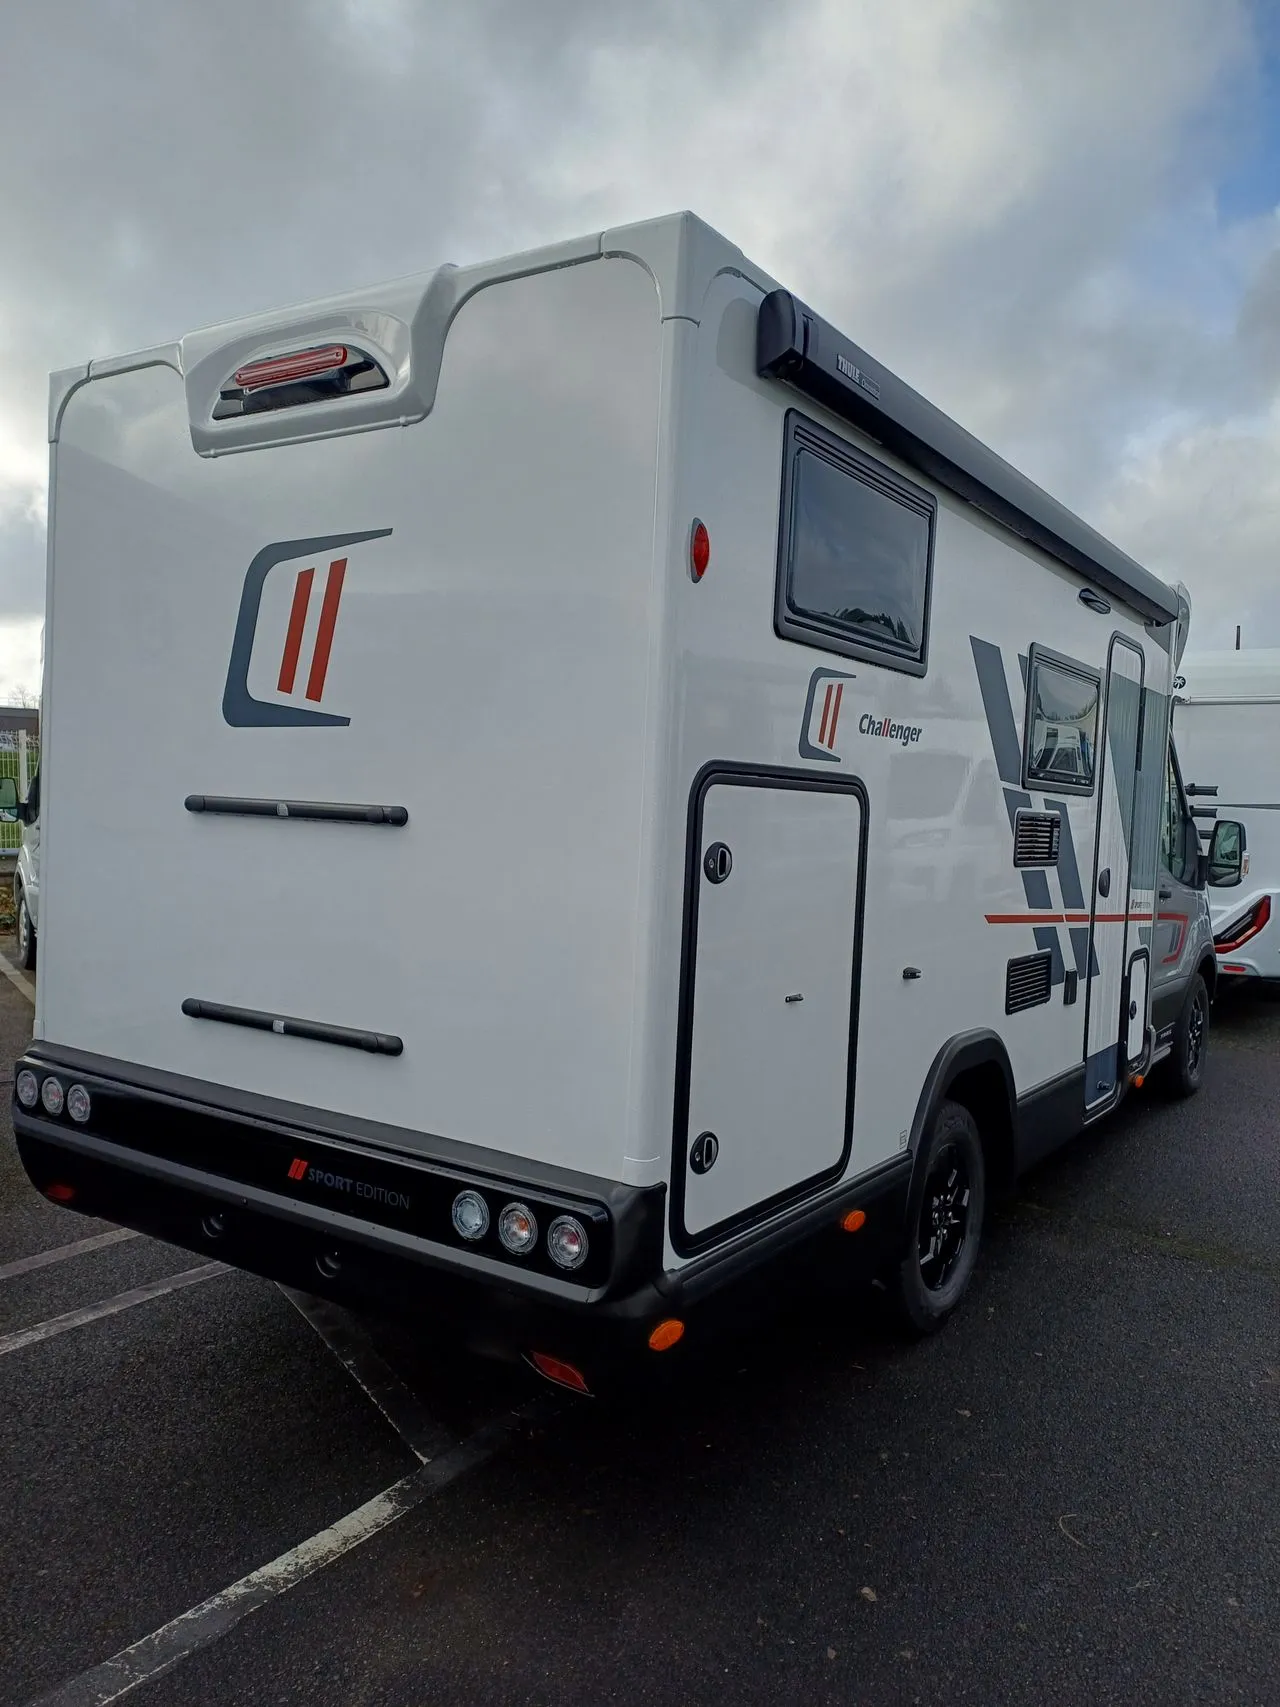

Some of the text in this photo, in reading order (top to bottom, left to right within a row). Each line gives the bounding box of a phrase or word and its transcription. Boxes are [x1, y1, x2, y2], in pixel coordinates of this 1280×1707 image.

[838, 355, 860, 384] THULE
[859, 713, 922, 747] Challenger
[308, 1168, 410, 1210] SPORT EDITION
